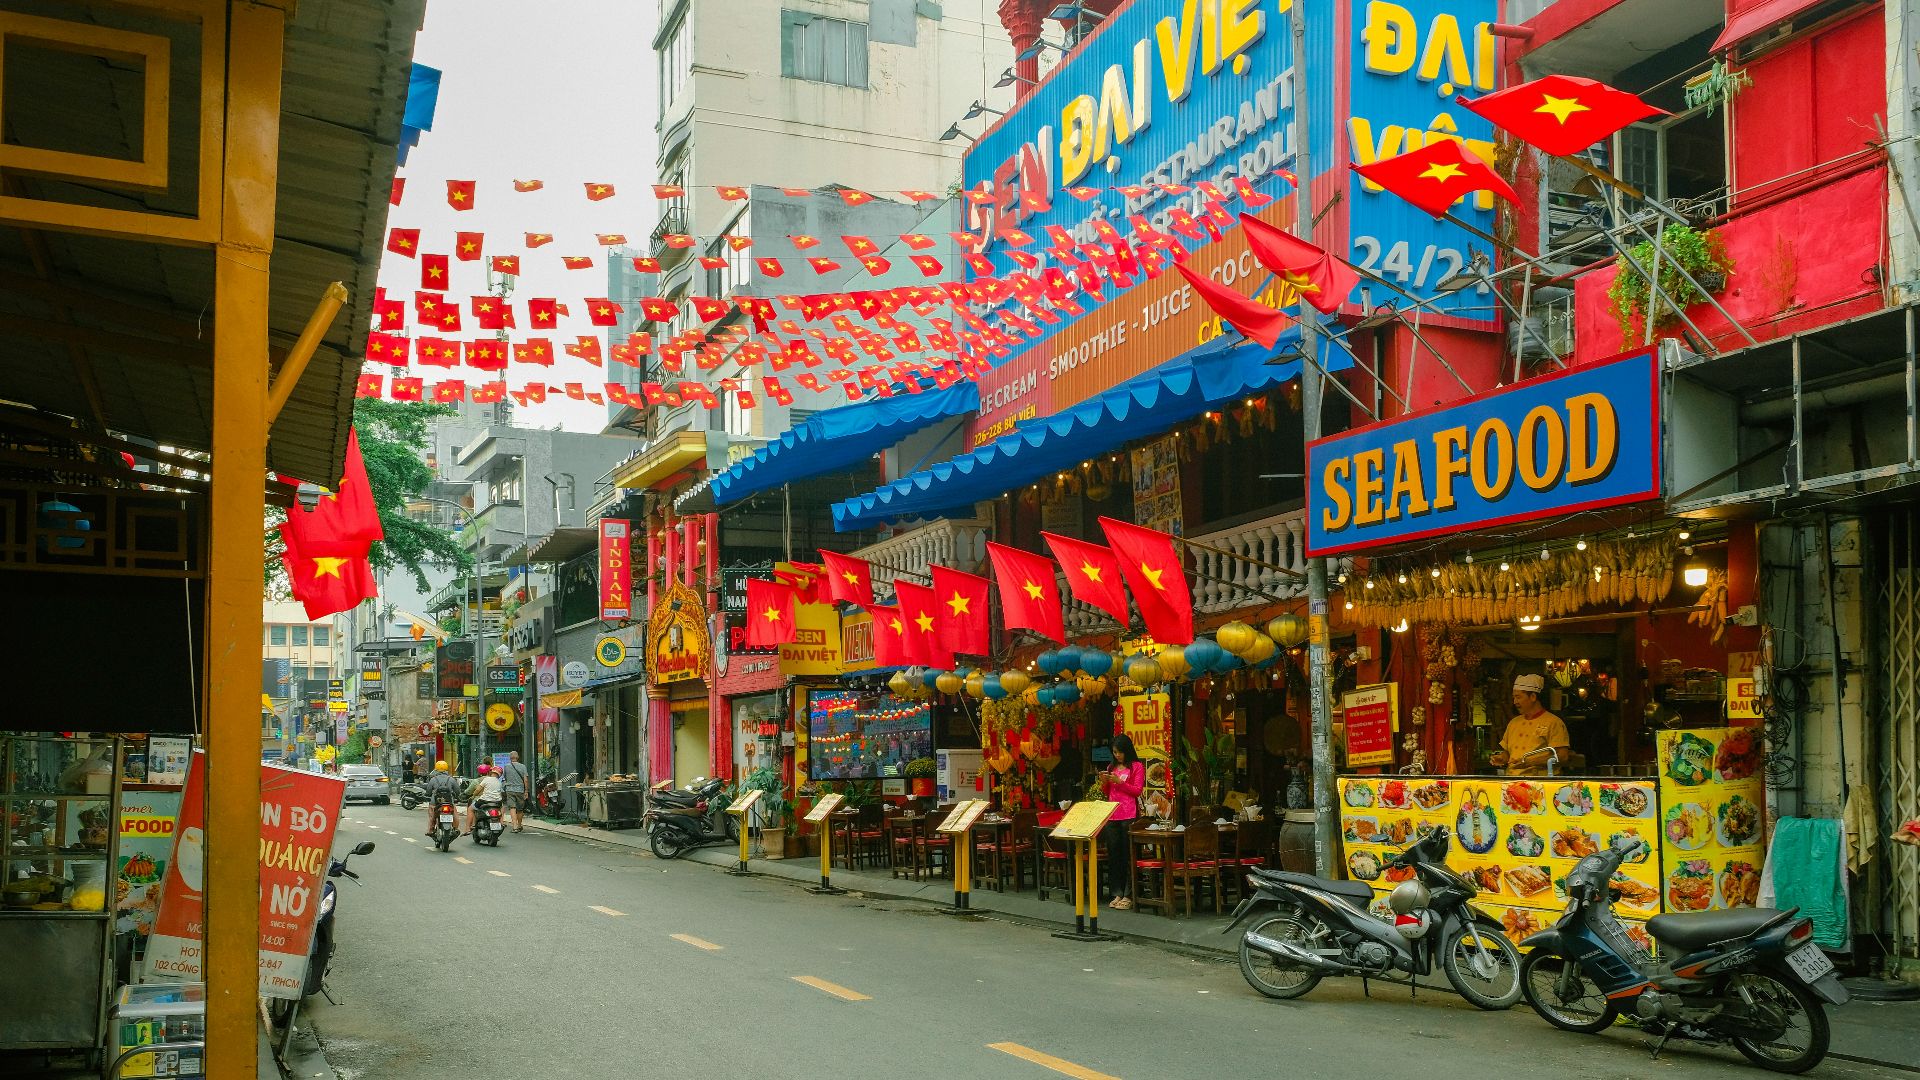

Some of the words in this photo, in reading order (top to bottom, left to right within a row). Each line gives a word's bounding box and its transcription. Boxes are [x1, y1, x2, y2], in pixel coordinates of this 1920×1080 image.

[1361, 0, 1495, 98] ĐẠI
[967, 125, 1053, 253] SEN
[1060, 39, 1152, 187] ĐẠI
[1125, 66, 1295, 218] RESTAURANT
[994, 369, 1037, 408] CREAM
[1049, 320, 1126, 381] SMOOTHIE
[1142, 284, 1191, 332] JUICE
[974, 421, 1002, 446] 226-228
[1322, 392, 1619, 533] SEAFOOD
[609, 538, 623, 602] INDIAN
[797, 631, 822, 643] SEN
[783, 649, 804, 664] ĐẠI
[807, 647, 837, 664] VIỆT
[490, 670, 517, 680] GS25
[1136, 703, 1156, 721] SEN
[1730, 701, 1749, 713] ĐẠI
[290, 803, 327, 834] BÒ
[269, 874, 311, 917] NỞ
[270, 920, 287, 929] SINCE
[262, 934, 285, 946] 14:00
[154, 959, 169, 970] 102
[272, 976, 300, 989] TPHCM
[1802, 957, 1829, 979] 3905
